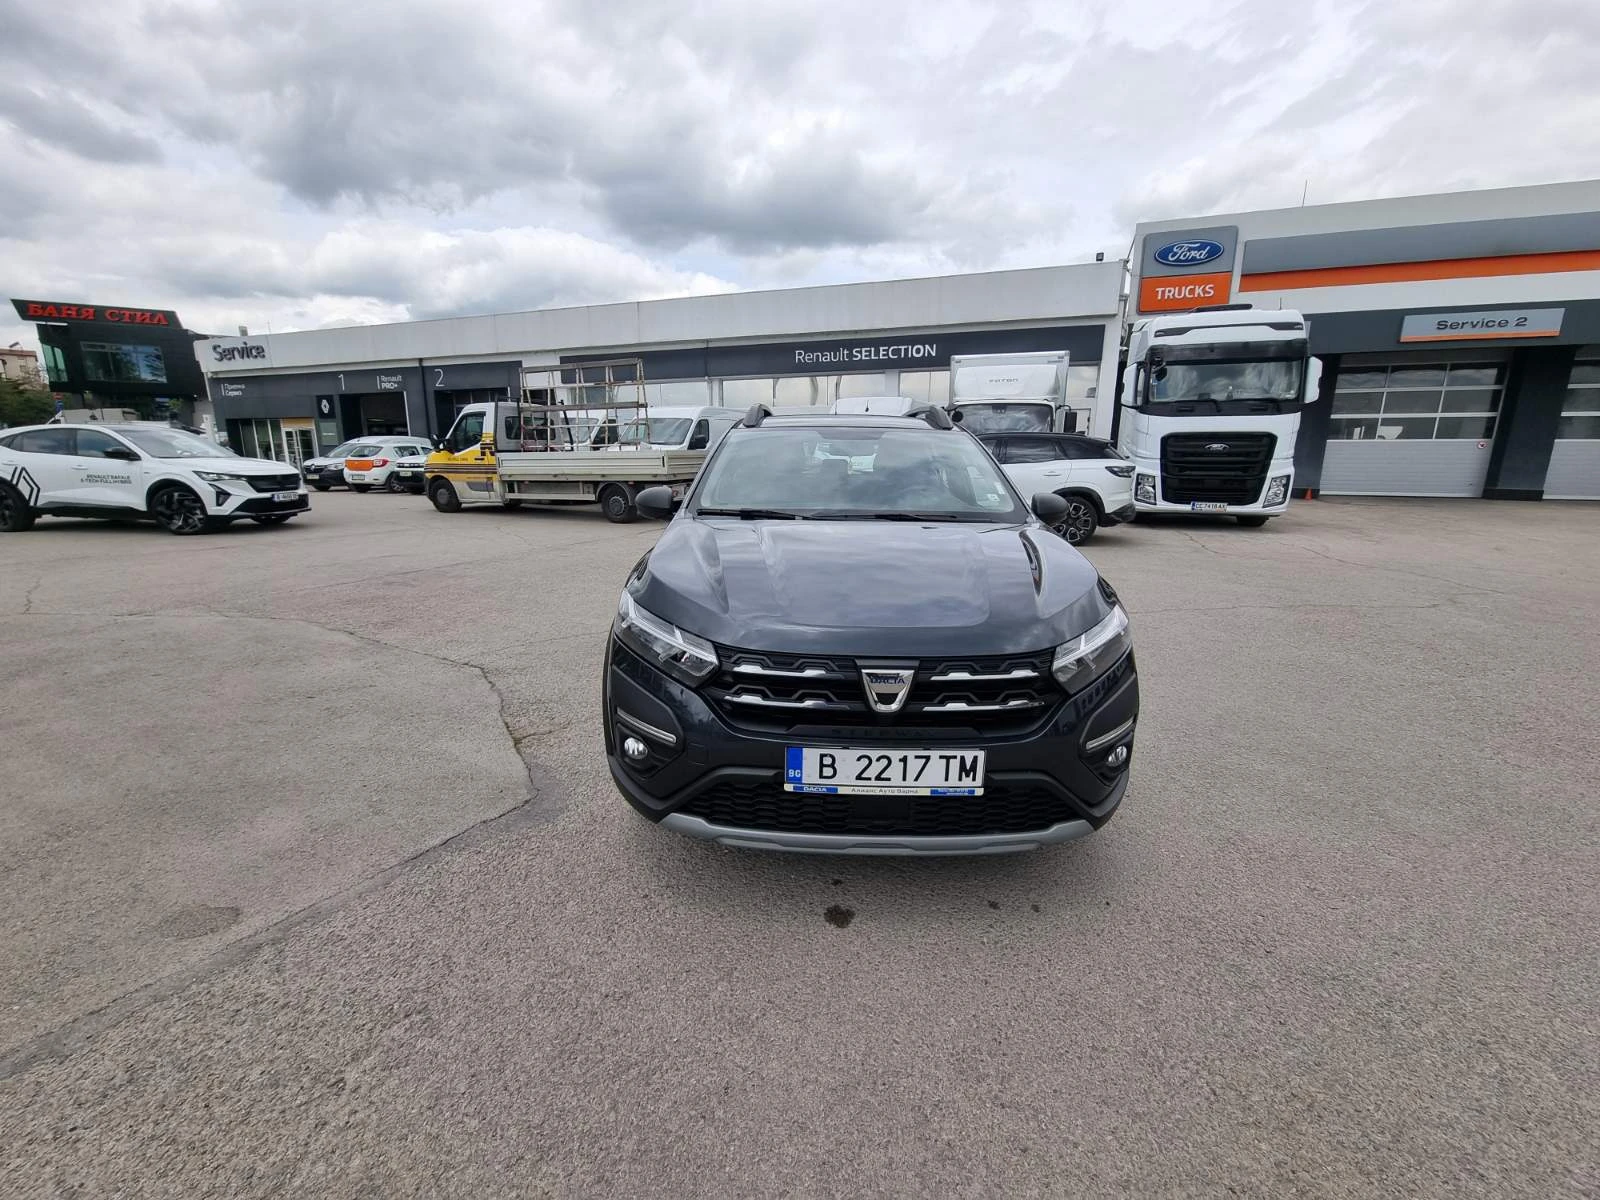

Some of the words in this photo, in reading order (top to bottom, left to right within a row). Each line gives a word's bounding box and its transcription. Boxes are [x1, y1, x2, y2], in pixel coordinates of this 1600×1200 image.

[1168, 243, 1210, 261] Ford
[1156, 284, 1215, 300] TRUCKS
[27, 303, 96, 320] БАНЯ
[104, 309, 169, 325] СТИЛ
[1436, 318, 1509, 330] Service
[1514, 316, 1528, 327] 2
[212, 341, 266, 362] Service
[795, 348, 849, 363] Renault
[852, 344, 936, 360] SELECTION
[338, 373, 345, 391] 1
[380, 374, 402, 382] Renault
[434, 368, 445, 387] 2
[788, 769, 801, 778] BG
[818, 753, 837, 780] B
[855, 754, 931, 782] 2217
[938, 755, 979, 782] TM
